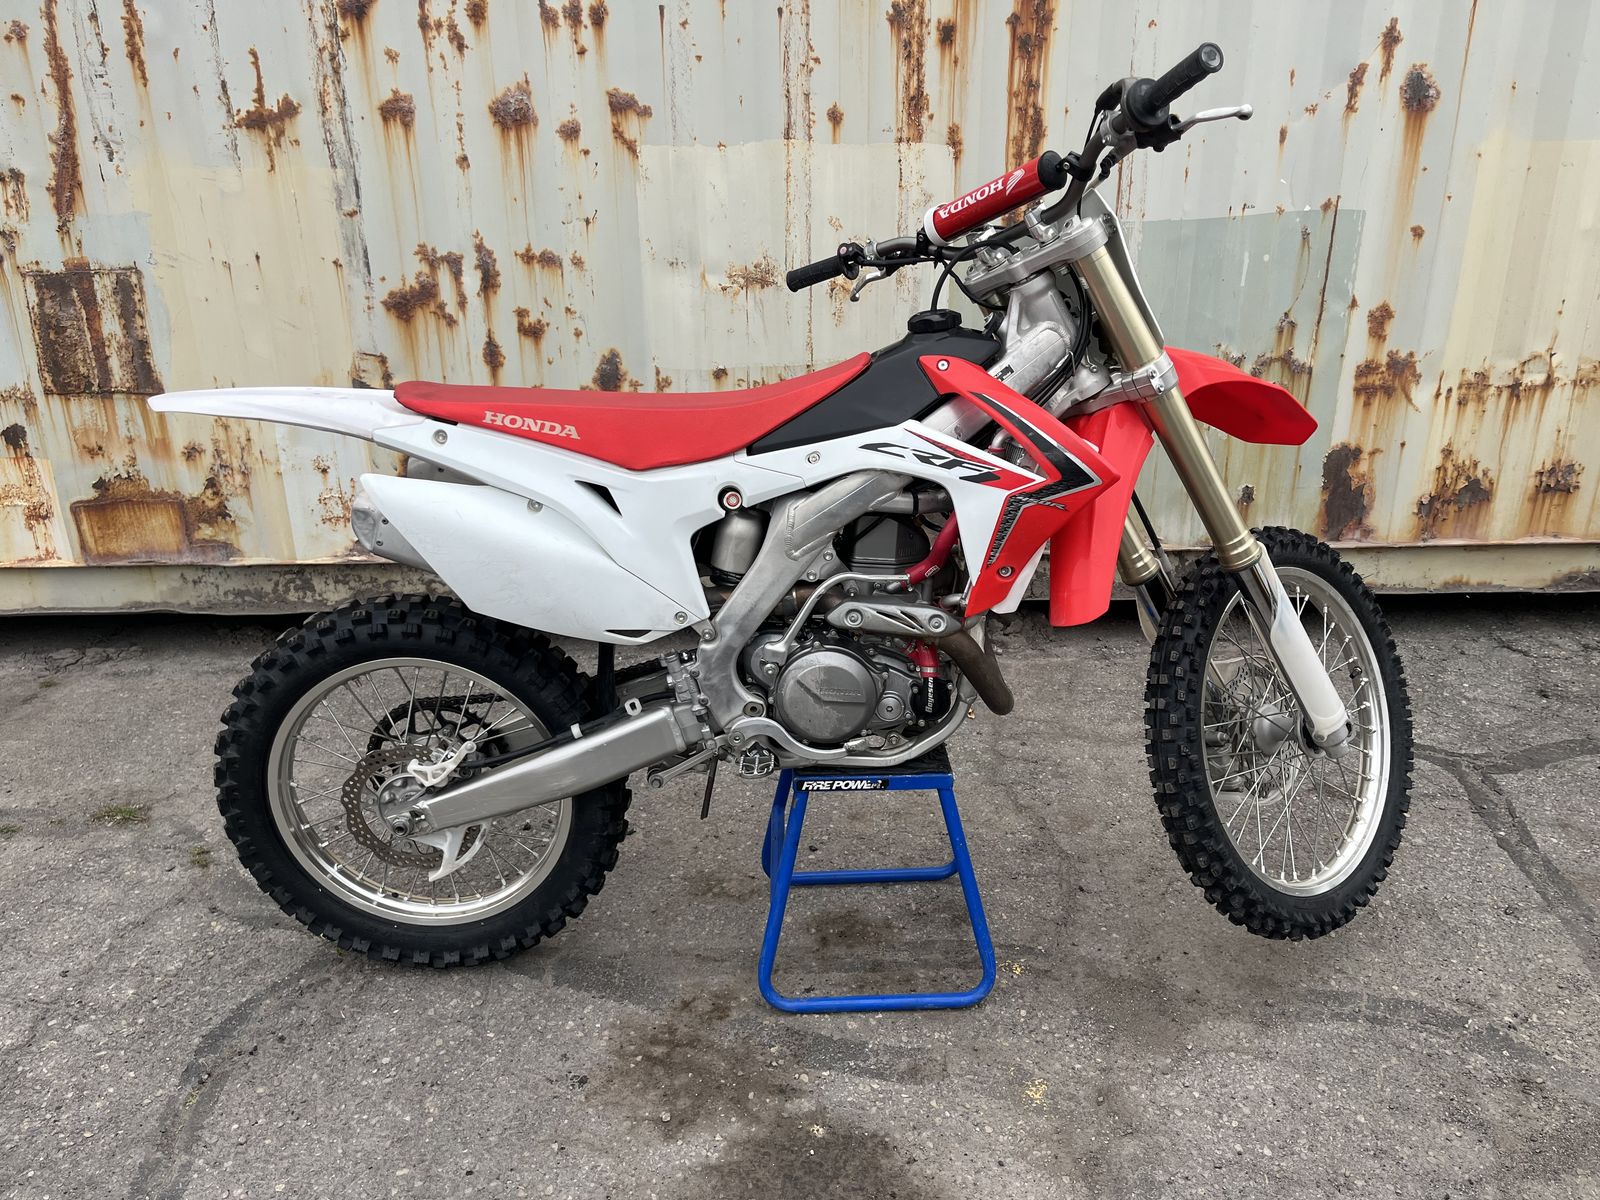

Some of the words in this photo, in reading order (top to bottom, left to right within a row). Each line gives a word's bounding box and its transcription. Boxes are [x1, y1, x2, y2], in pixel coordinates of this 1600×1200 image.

[938, 177, 1004, 219] HONDA
[482, 411, 580, 439] HONDA
[858, 442, 997, 473] CRF
[925, 676, 934, 712] Boyesen
[801, 781, 832, 790] FIRE
